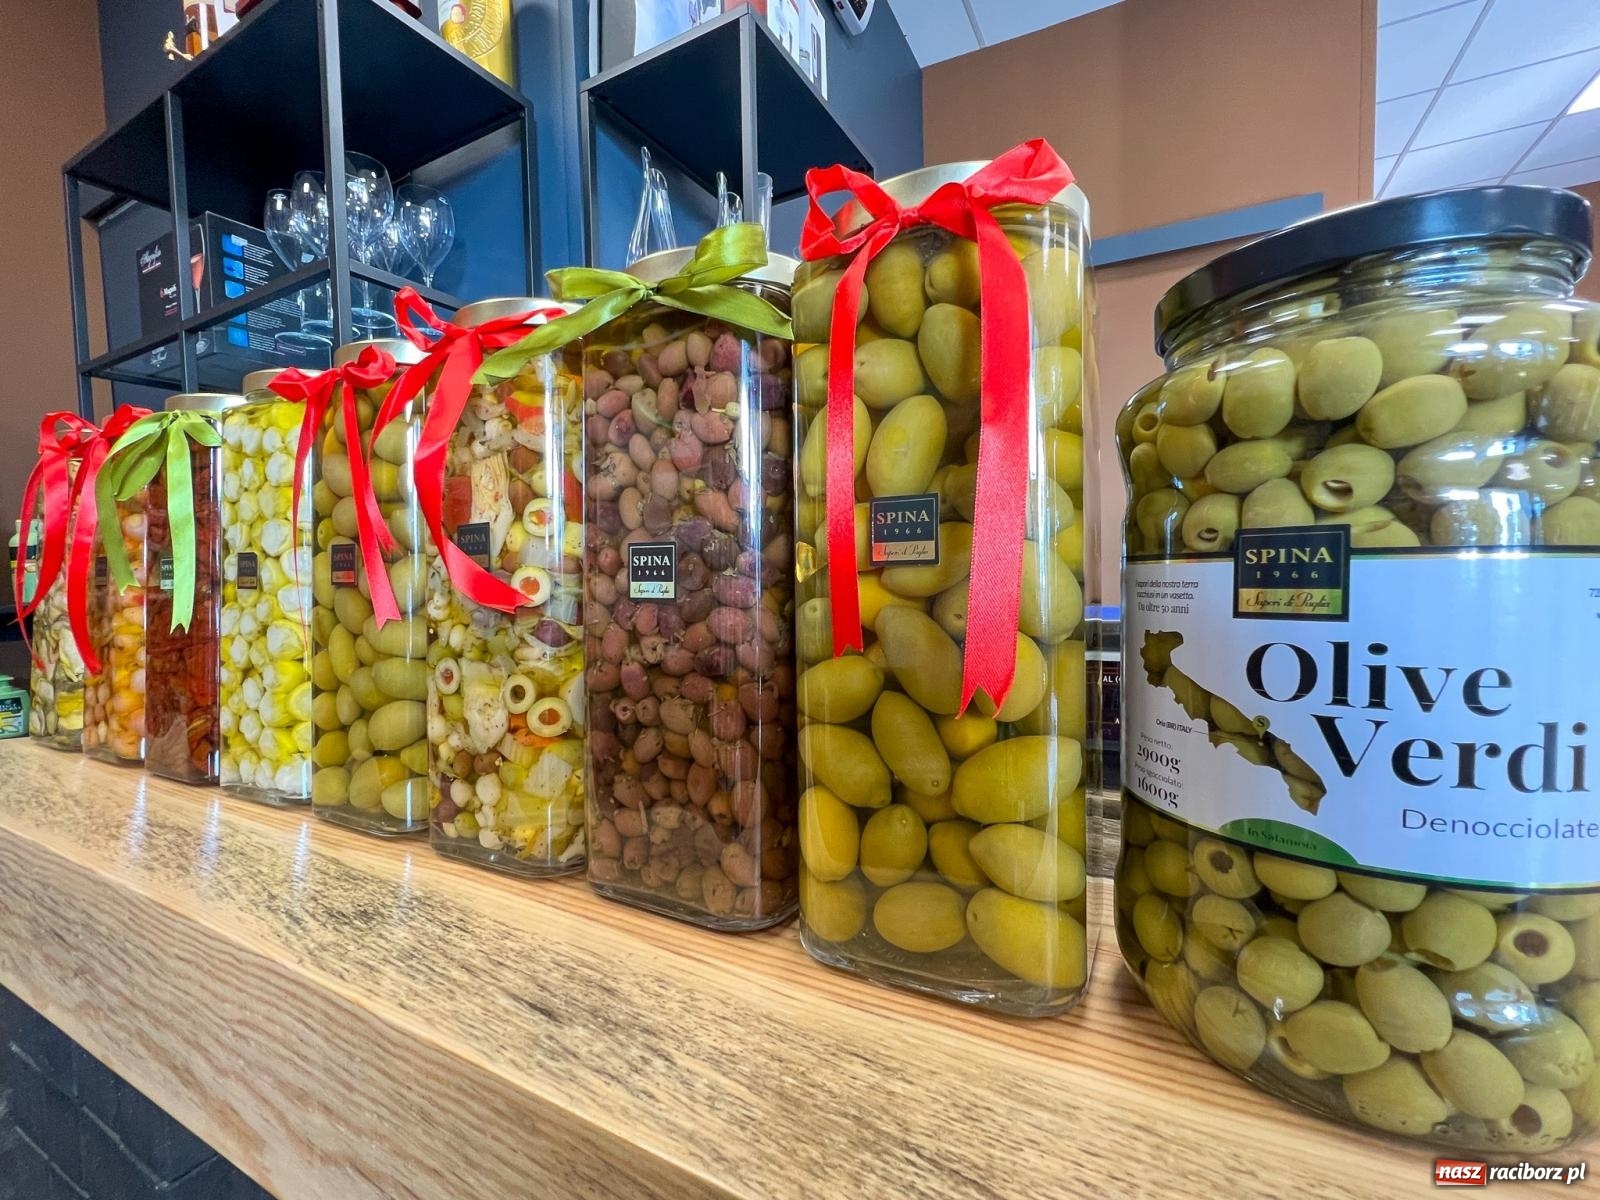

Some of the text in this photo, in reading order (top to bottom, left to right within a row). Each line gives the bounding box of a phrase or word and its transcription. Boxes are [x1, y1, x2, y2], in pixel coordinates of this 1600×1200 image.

[876, 509, 930, 525] SPINA
[460, 533, 487, 544] SPINA
[632, 554, 671, 567] SPINA
[1245, 546, 1334, 565] SPINA
[1162, 580, 1181, 588] nostra
[1182, 580, 1199, 588] terra
[1146, 602, 1160, 613] oltre
[1161, 605, 1170, 614] 50
[1170, 603, 1190, 614] anni
[1246, 641, 1513, 717] Olive
[1177, 724, 1193, 734] ITALY
[1136, 743, 1181, 775] 2900g
[1309, 713, 1591, 793] Verdi
[1137, 776, 1179, 809] 1600g
[1402, 808, 1600, 839] Denocciolate
